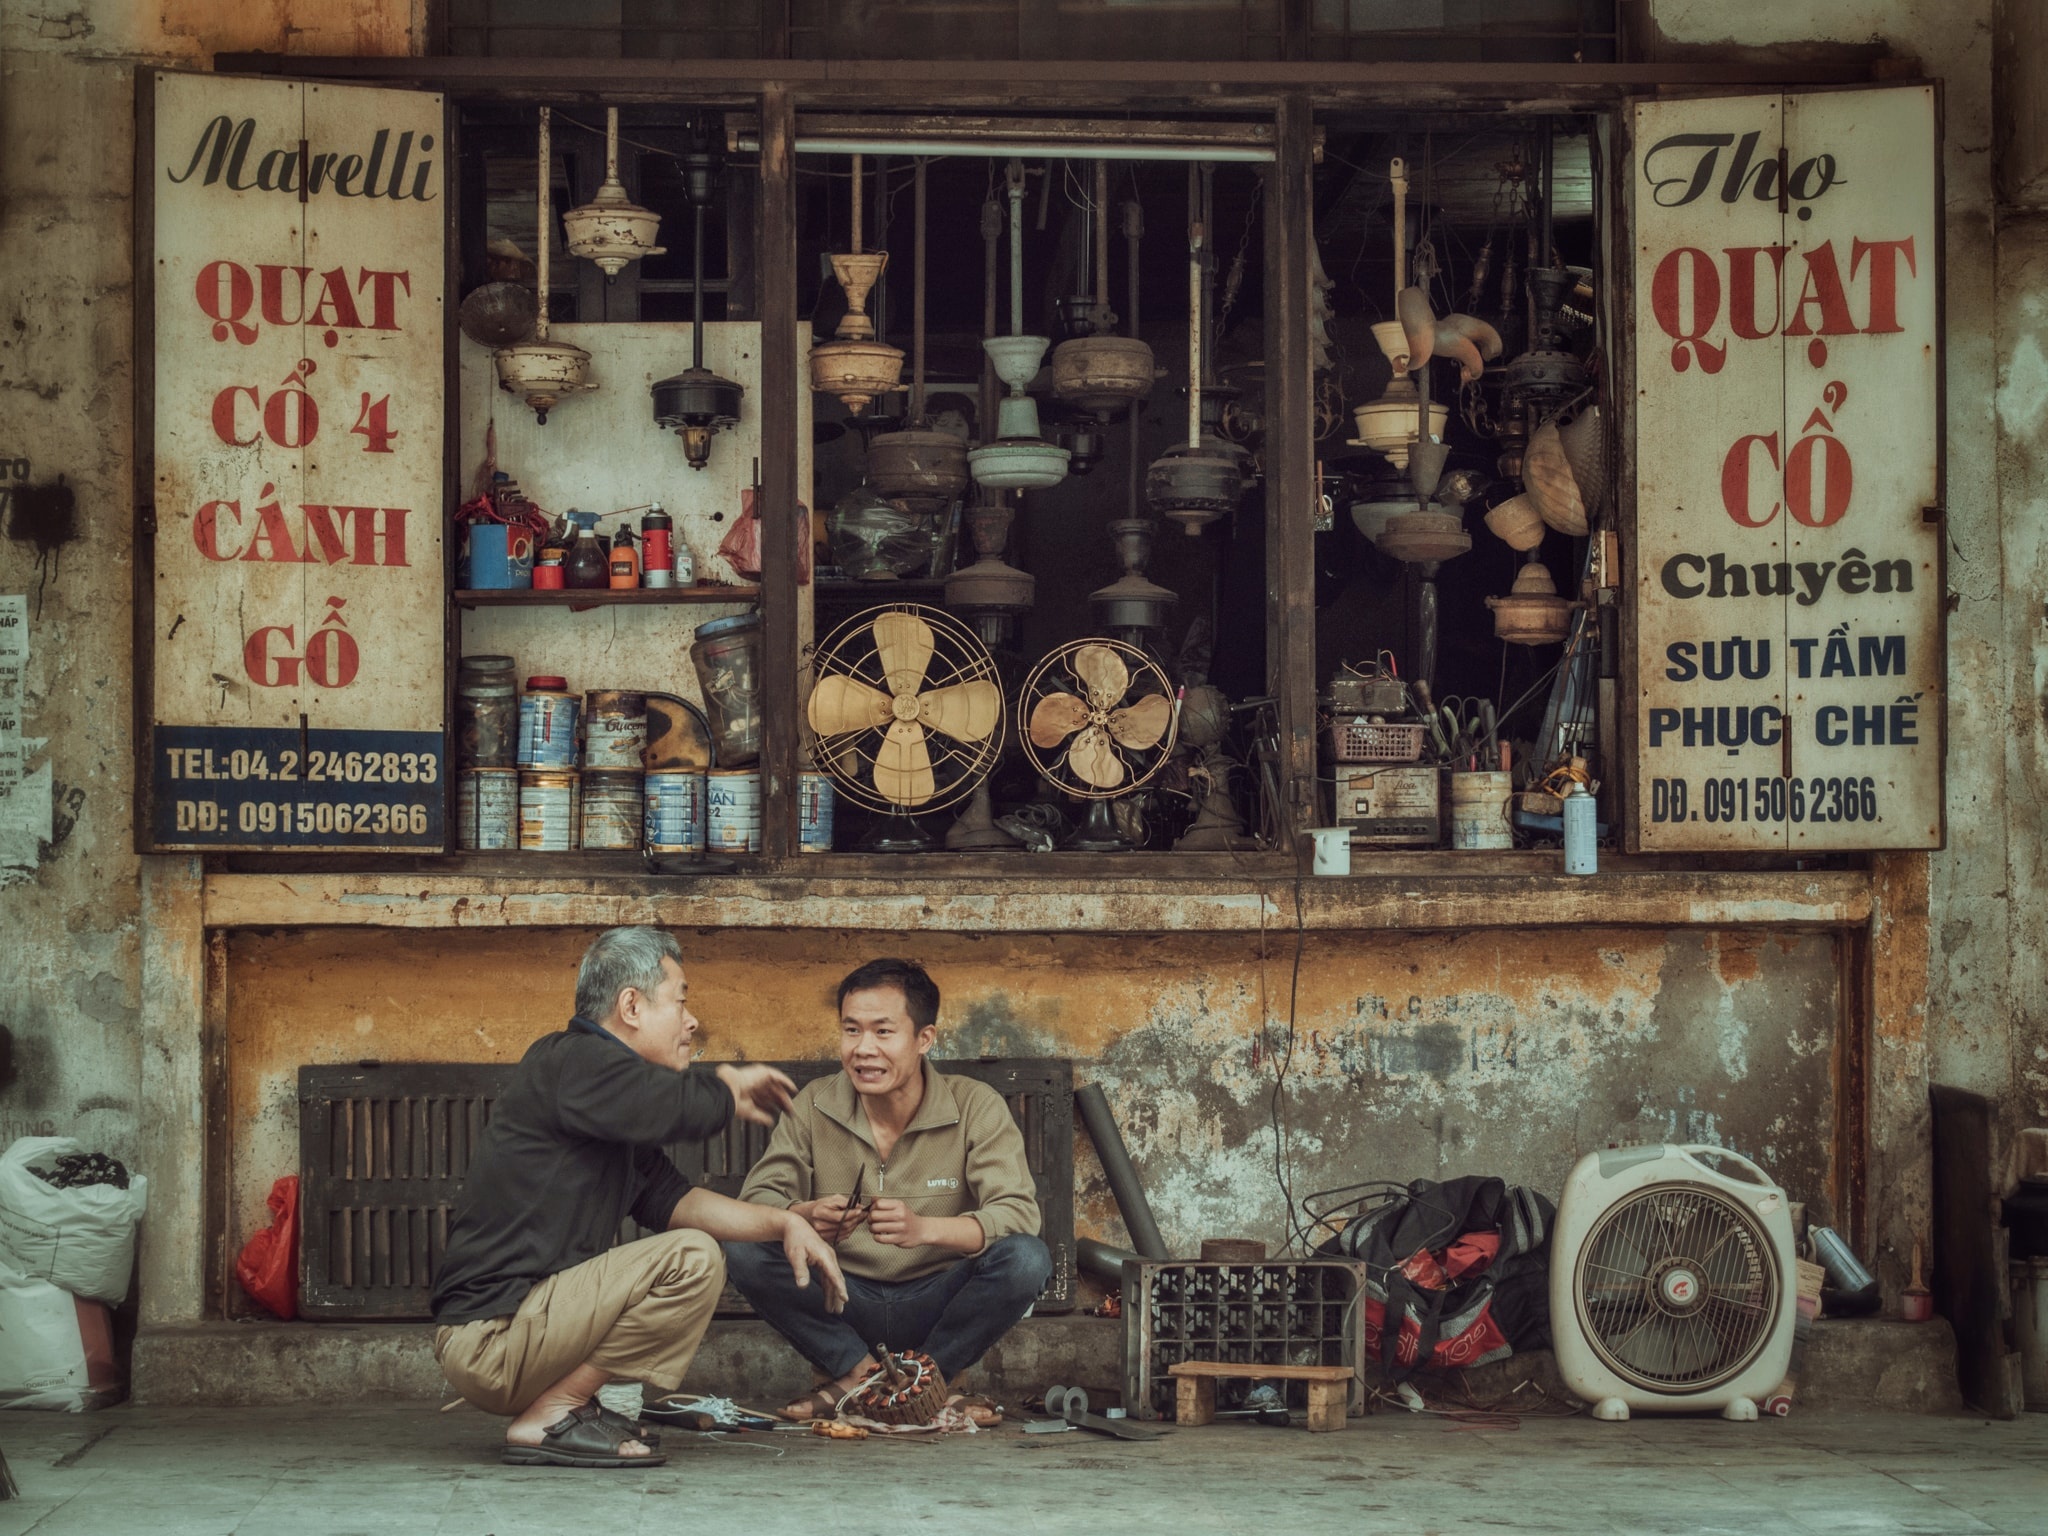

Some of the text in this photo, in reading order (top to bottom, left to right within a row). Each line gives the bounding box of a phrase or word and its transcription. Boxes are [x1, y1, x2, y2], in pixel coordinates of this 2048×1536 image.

[167, 115, 437, 201] Marelli
[195, 260, 411, 348] QUẠT
[1651, 235, 1916, 375] QUẠT
[212, 358, 398, 453] CỔ 4
[1721, 380, 1853, 528] CỔ
[193, 482, 412, 567] CÁNH
[1660, 547, 1914, 607] Chuyên
[243, 596, 360, 689] GỖ
[1665, 621, 1906, 682] SƯU TẦM
[1649, 692, 1924, 756] PHỤC CHẾ
[238, 801, 427, 834] 0915062366
